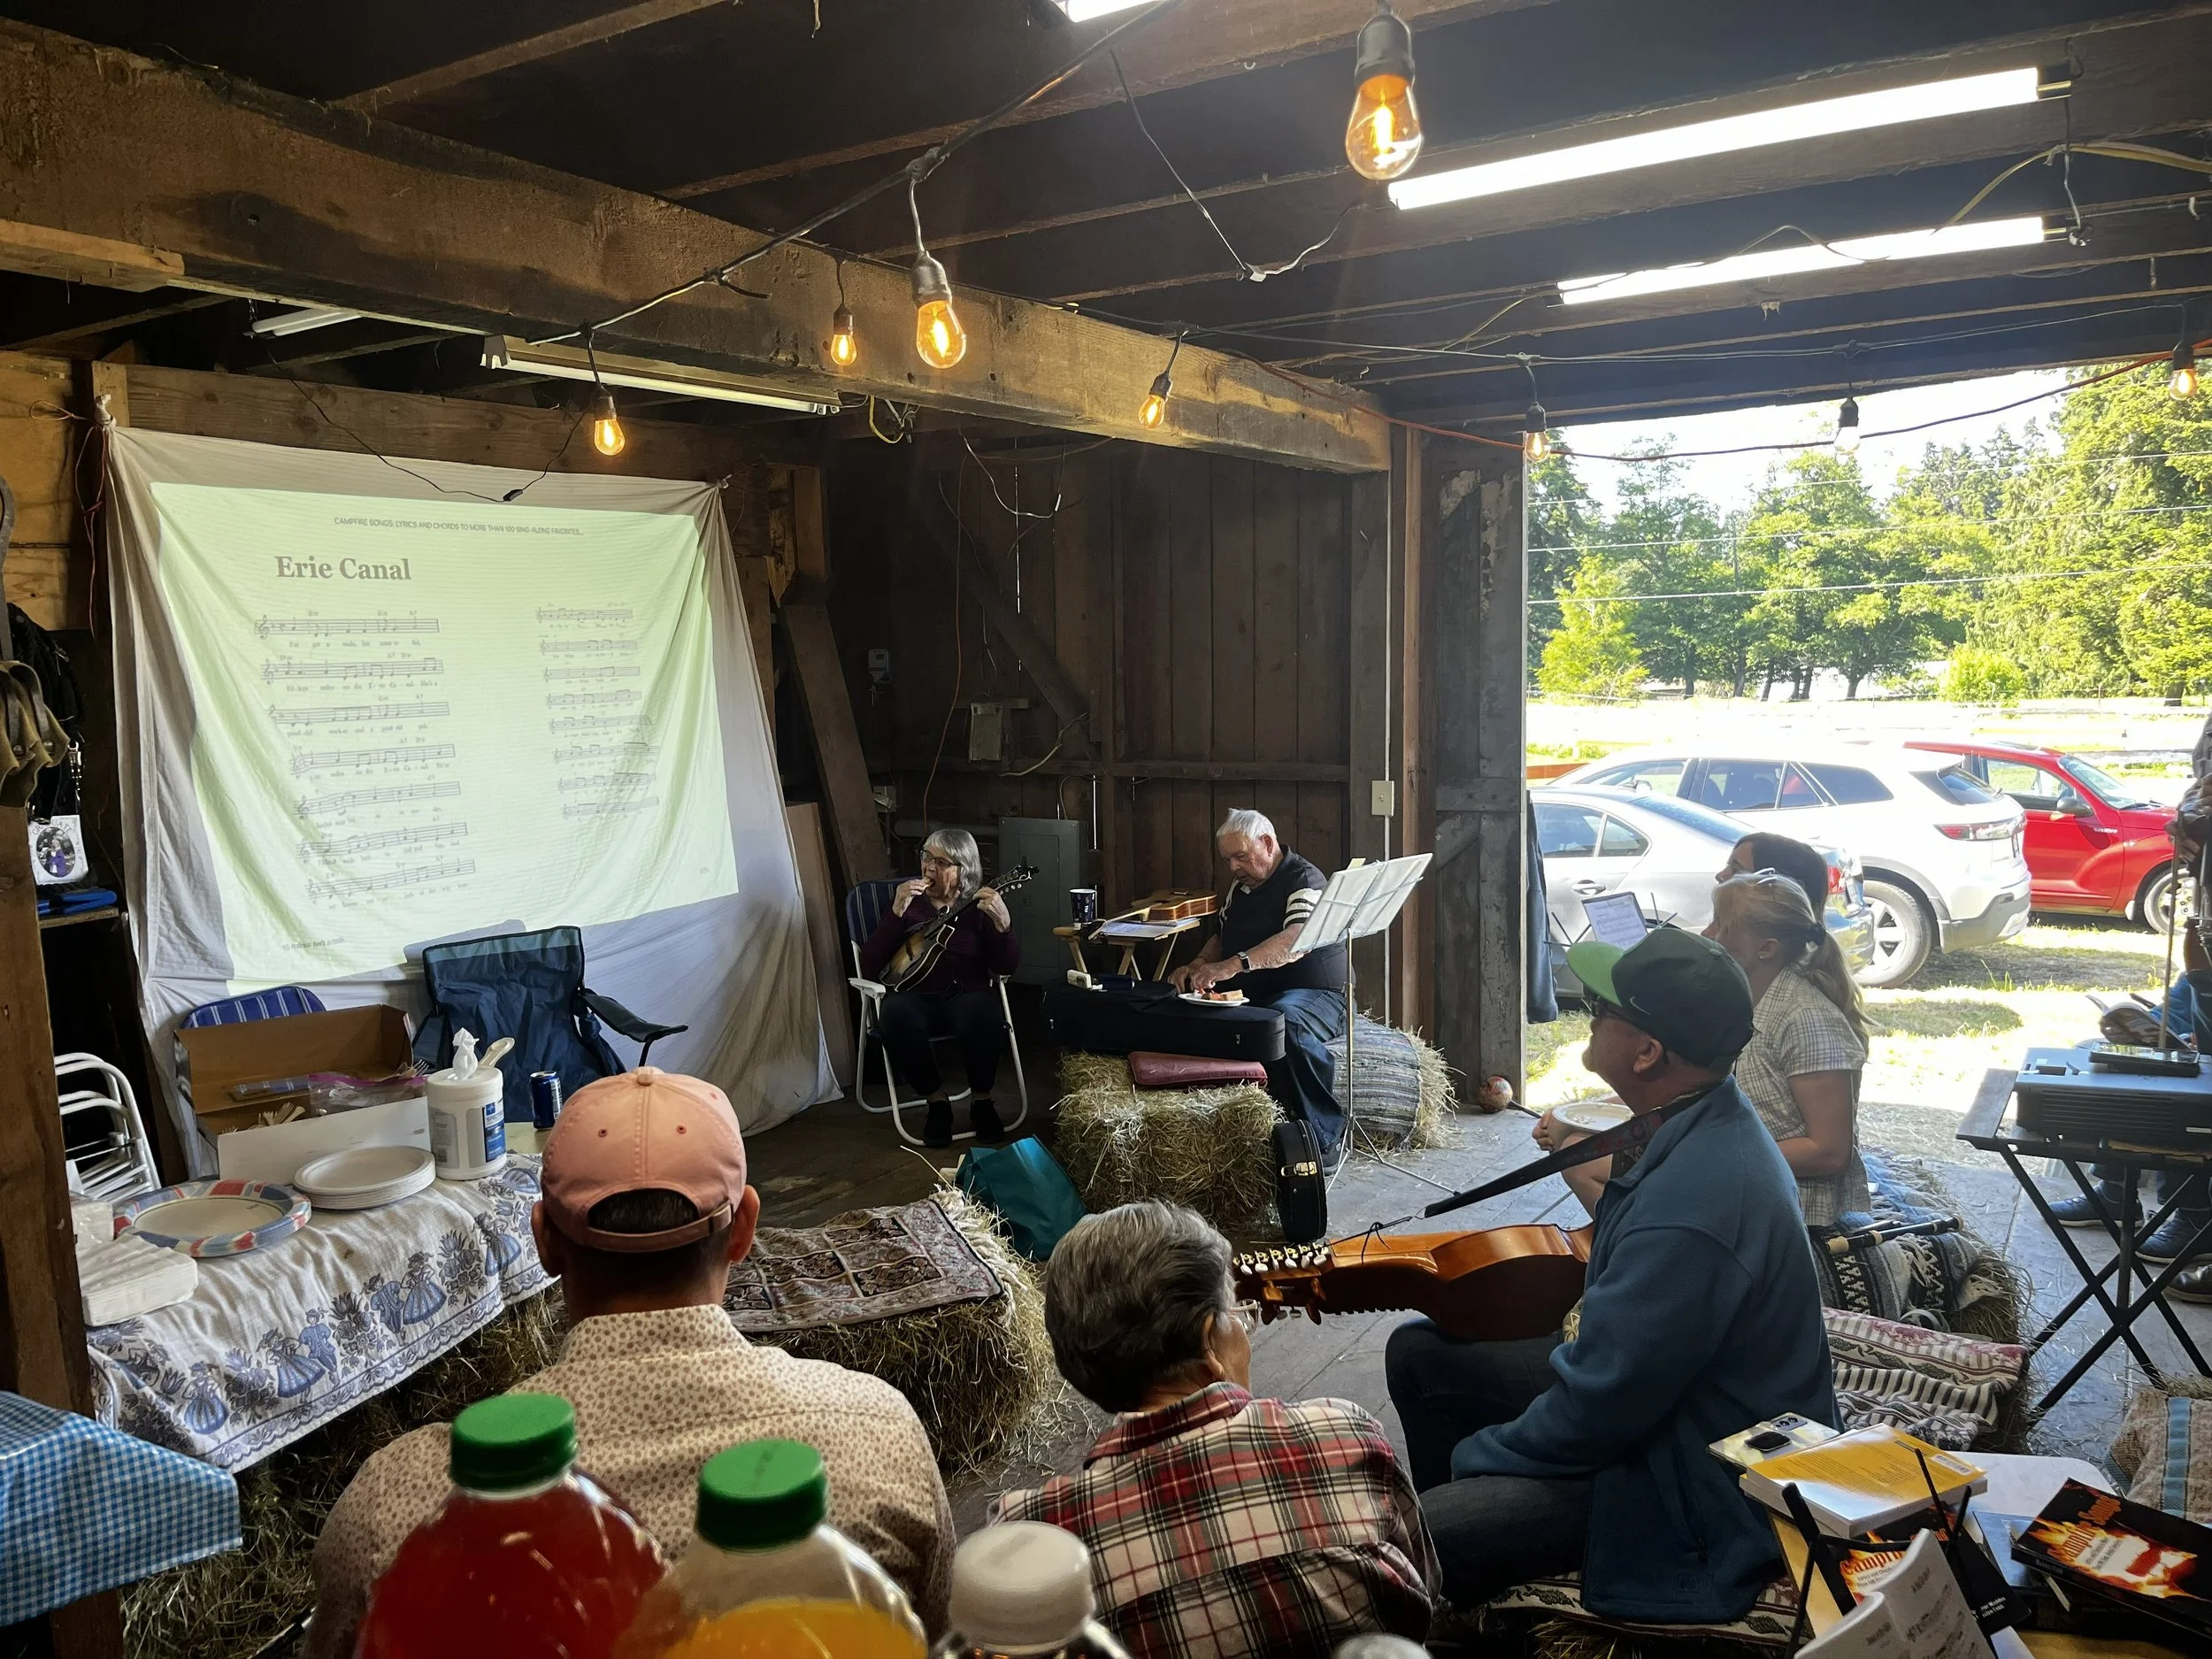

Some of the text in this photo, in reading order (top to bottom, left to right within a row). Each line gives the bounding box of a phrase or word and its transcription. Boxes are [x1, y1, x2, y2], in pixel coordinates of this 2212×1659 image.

[334, 517, 367, 526] CAMPFIRE
[369, 518, 395, 527] SONGS:
[395, 519, 418, 528] LYRICS
[274, 556, 412, 580] Erie Canal
